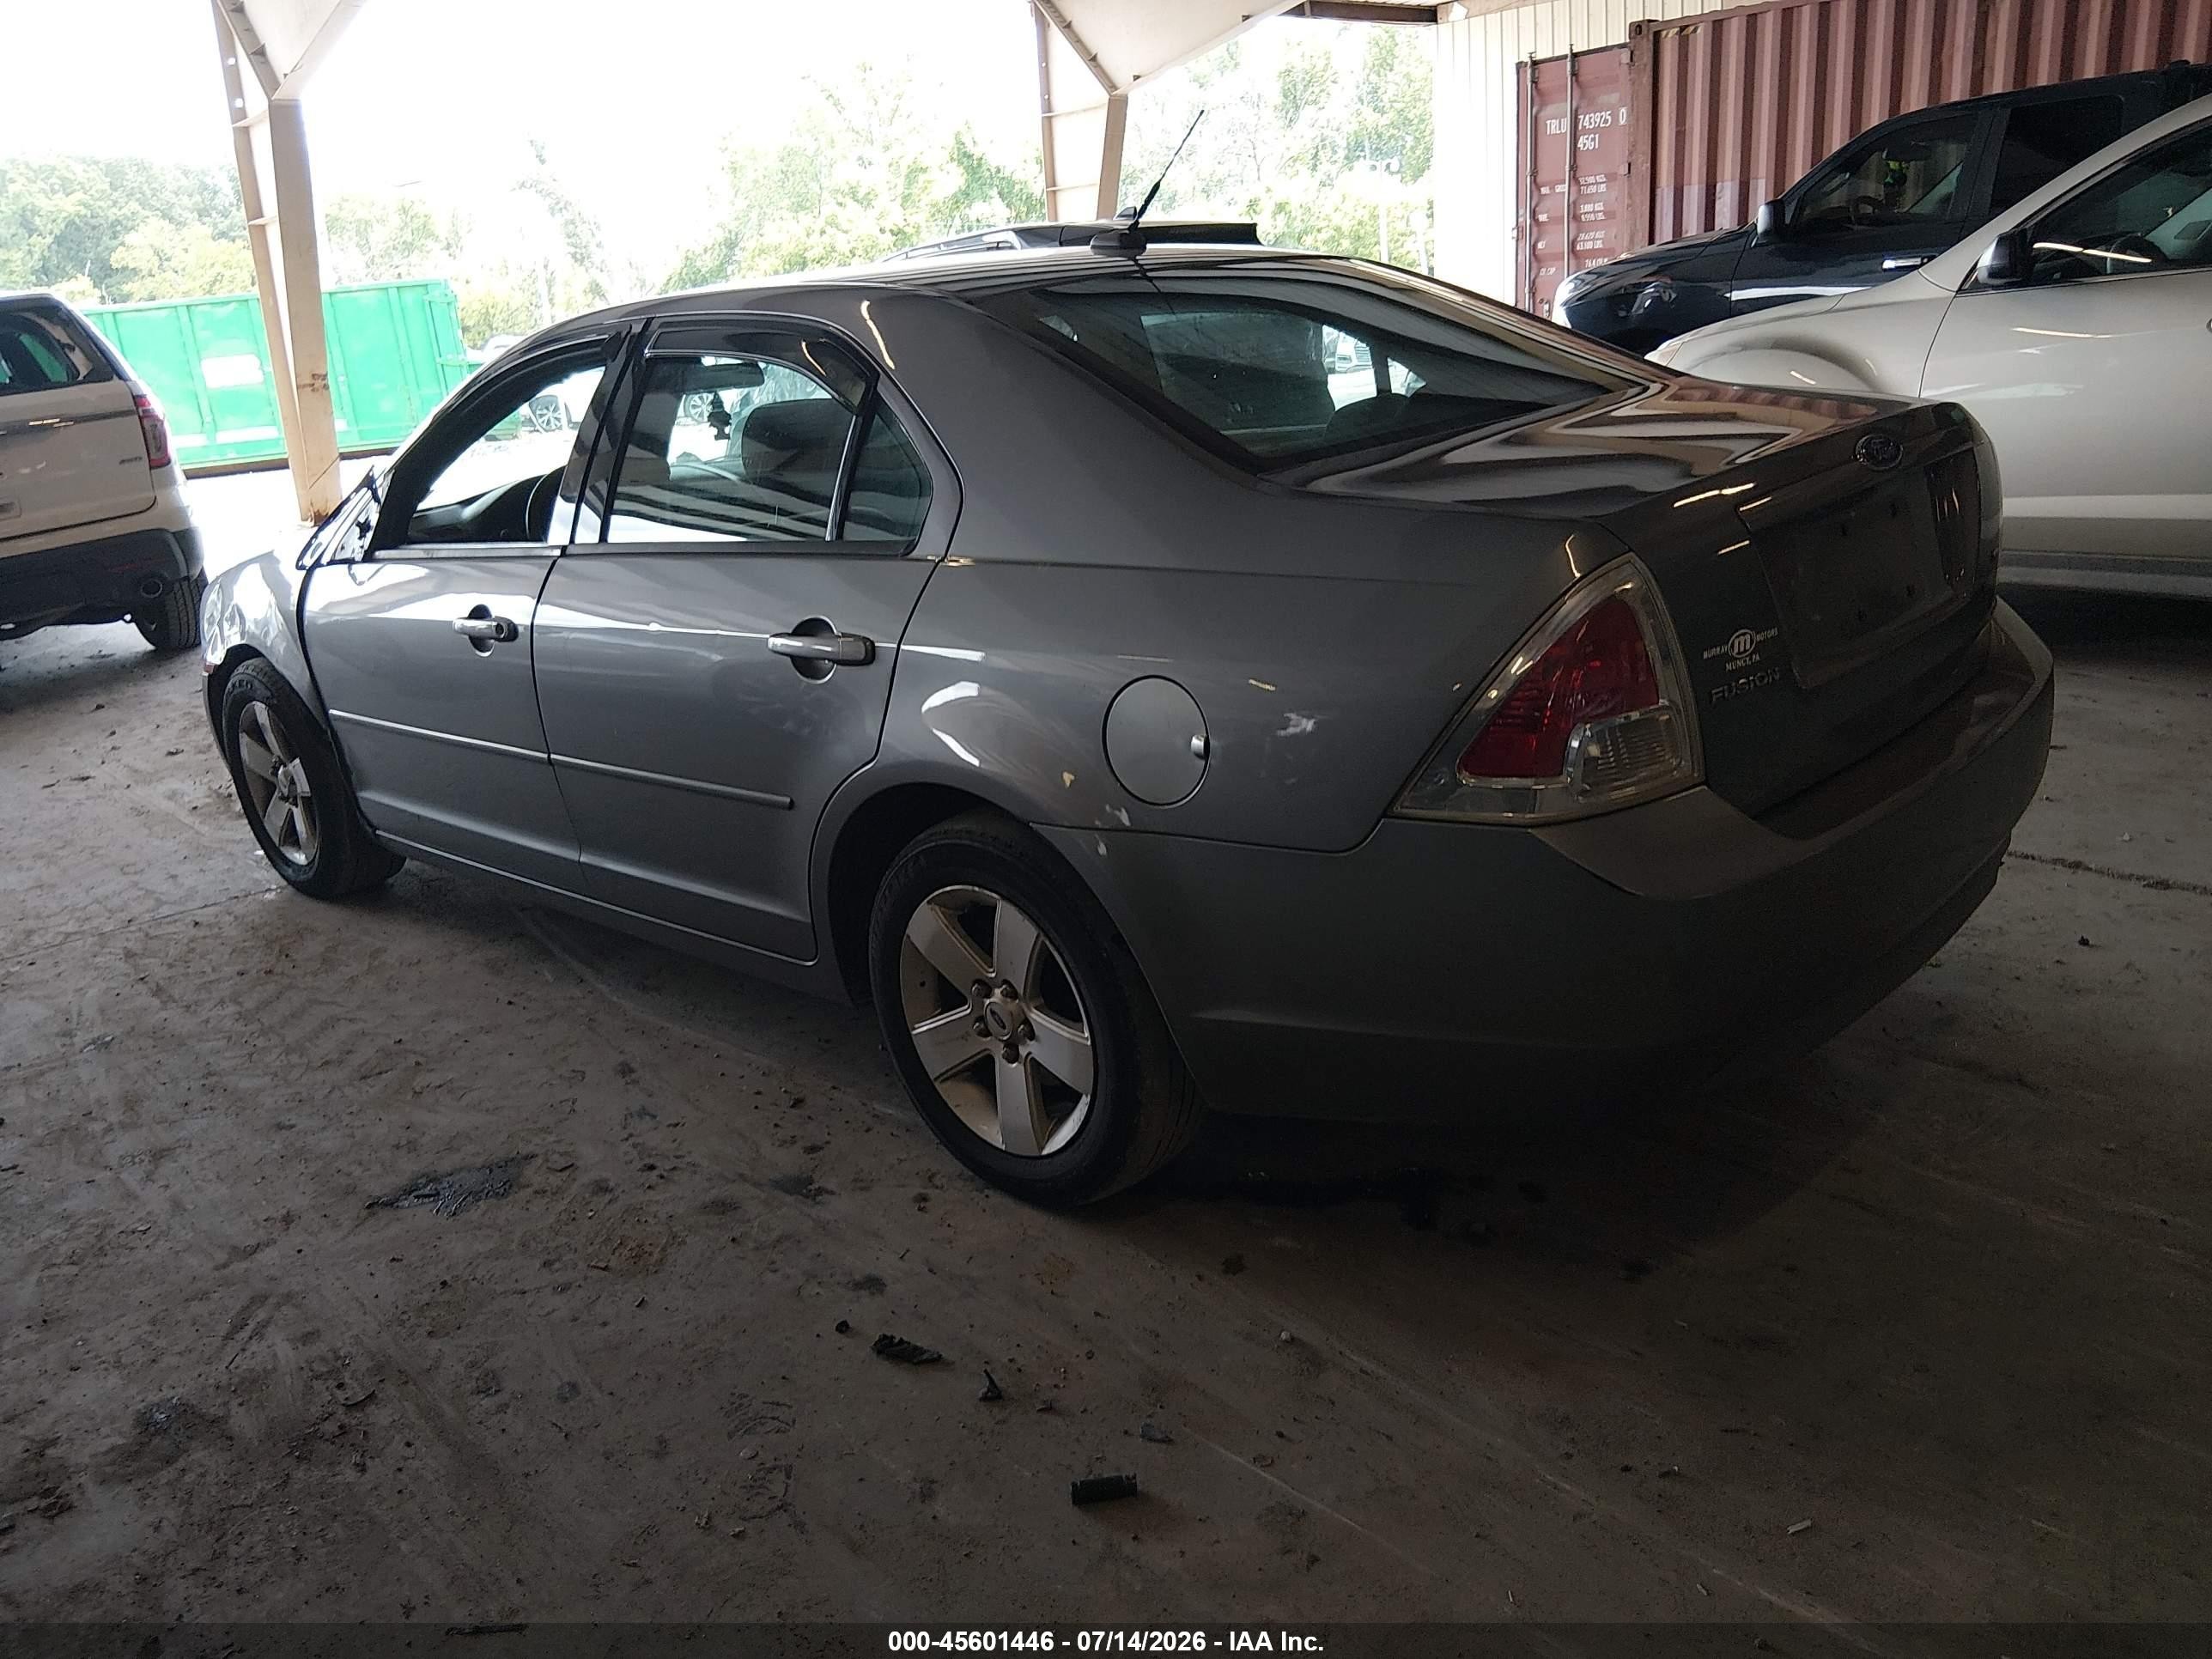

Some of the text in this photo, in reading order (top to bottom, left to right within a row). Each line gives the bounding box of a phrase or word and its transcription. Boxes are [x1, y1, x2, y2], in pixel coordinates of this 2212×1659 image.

[1546, 118, 1567, 135] TRLU
[1578, 111, 1612, 130] 743925
[1577, 134, 1599, 150] 45G1
[1756, 627, 1779, 642] MOTORS
[1703, 645, 1728, 660] MURRAY
[1711, 665, 1780, 702] FUSION
